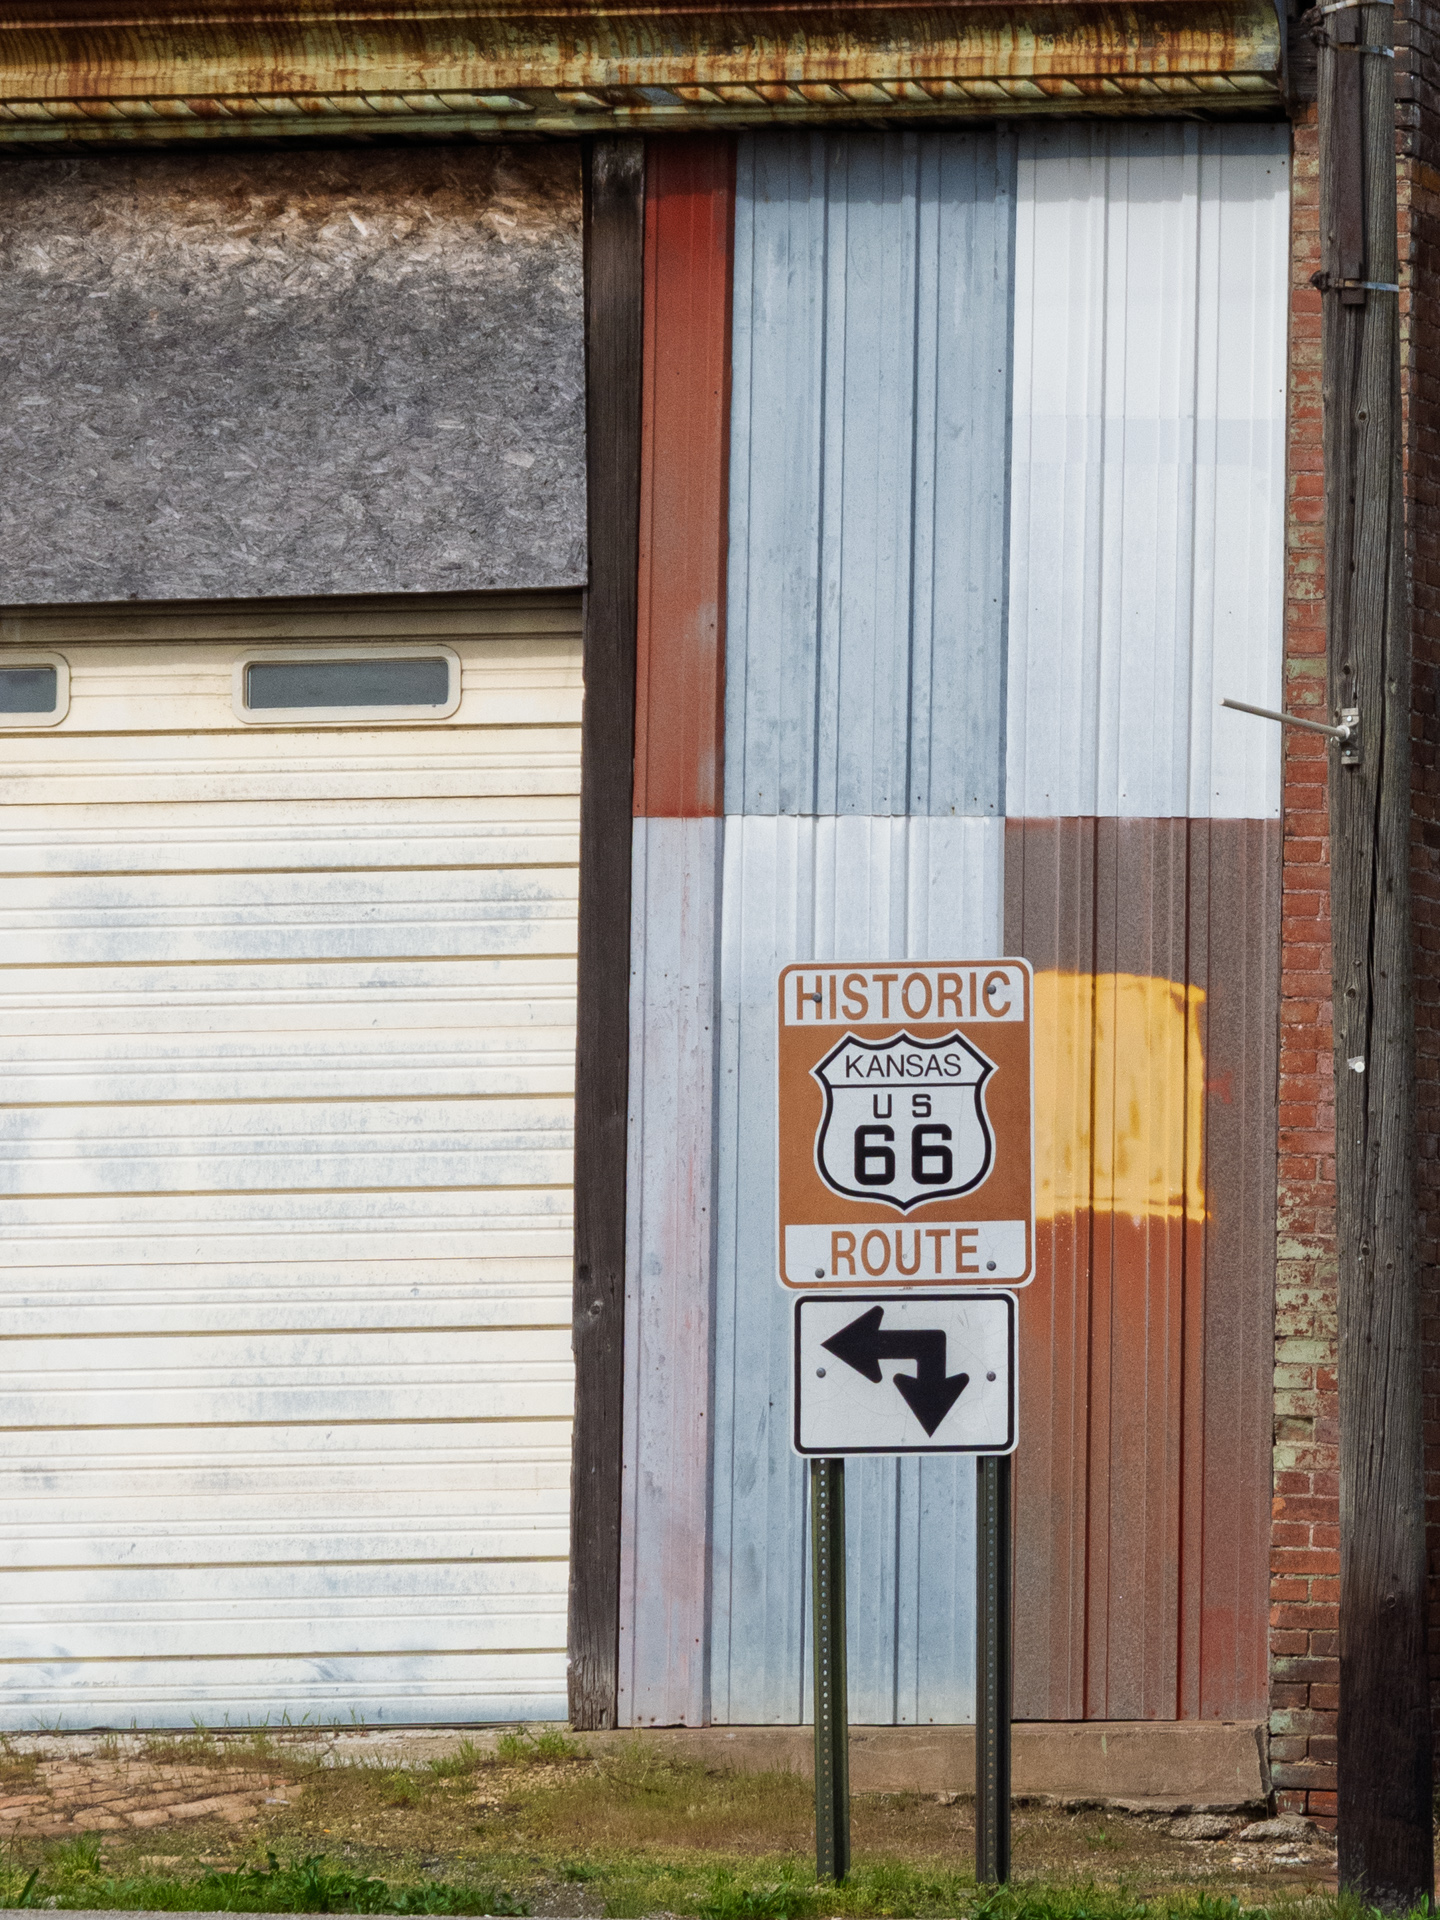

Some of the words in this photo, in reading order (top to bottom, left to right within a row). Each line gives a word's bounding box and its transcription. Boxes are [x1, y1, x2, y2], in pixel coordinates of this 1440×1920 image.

[796, 970, 1011, 1020] HISTORIC
[846, 1053, 962, 1078] KANSAS
[854, 1123, 953, 1185] 66
[831, 1228, 980, 1276] ROUTE
